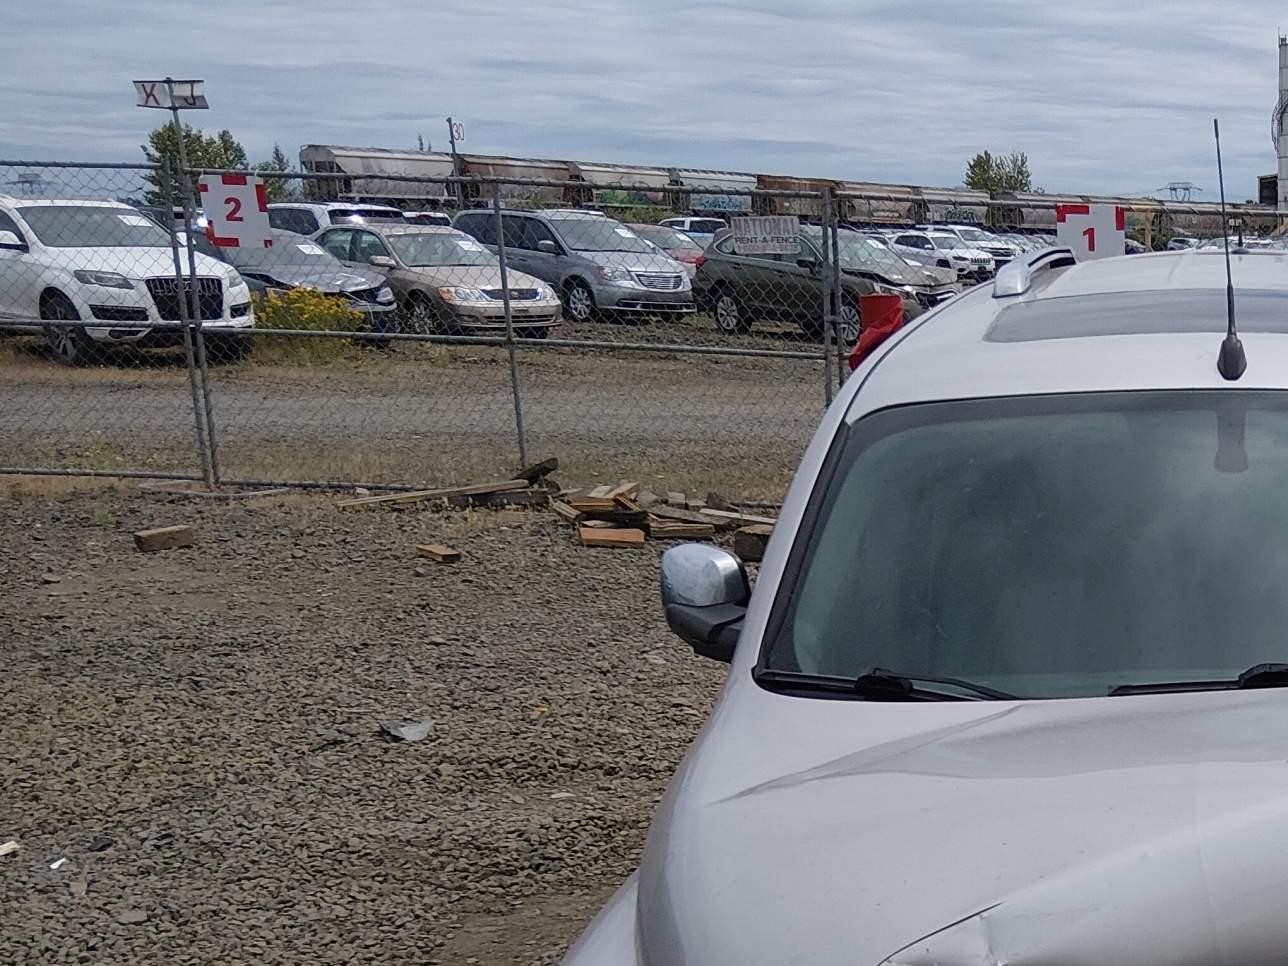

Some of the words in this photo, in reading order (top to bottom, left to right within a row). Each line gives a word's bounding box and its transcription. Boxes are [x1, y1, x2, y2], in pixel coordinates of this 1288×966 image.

[183, 83, 196, 106] J
[453, 122, 464, 141] 30
[224, 197, 244, 222] 2
[735, 217, 798, 236] NATIONAL
[735, 236, 800, 244] RENT-A-FENCE
[1083, 227, 1095, 252] 1
